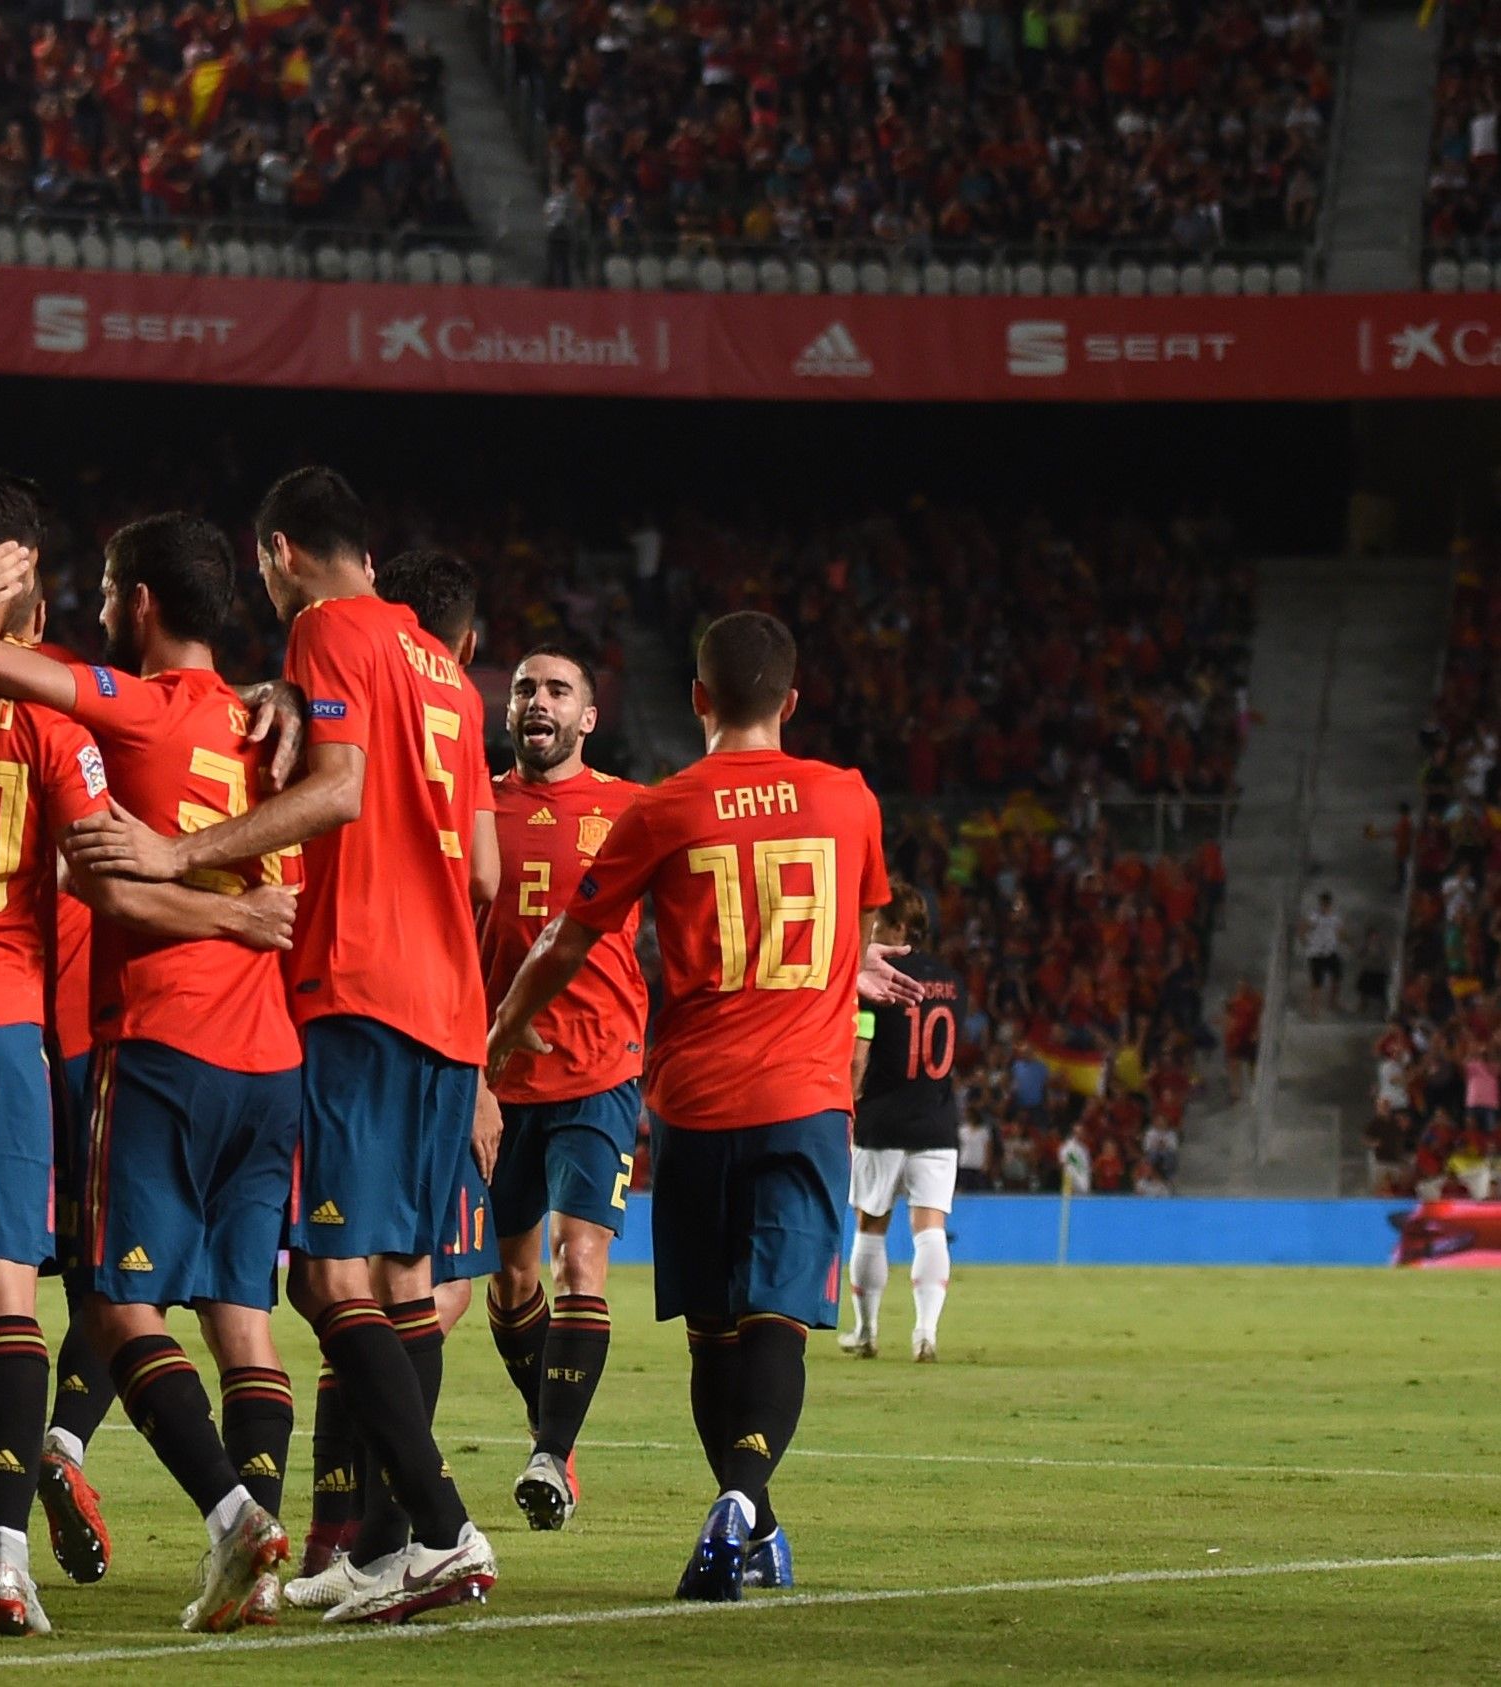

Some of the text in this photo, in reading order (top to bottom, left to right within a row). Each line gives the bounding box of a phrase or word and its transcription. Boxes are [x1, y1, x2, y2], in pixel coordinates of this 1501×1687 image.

[100, 313, 238, 345] SEAT
[437, 320, 640, 366] CaixaBank
[1083, 334, 1237, 361] SEAT
[312, 704, 346, 715] SPECT
[713, 780, 799, 821] GAYÀ
[518, 861, 551, 917] 2
[687, 837, 837, 992] 18
[904, 1005, 957, 1081] 10
[610, 1152, 635, 1211] 2
